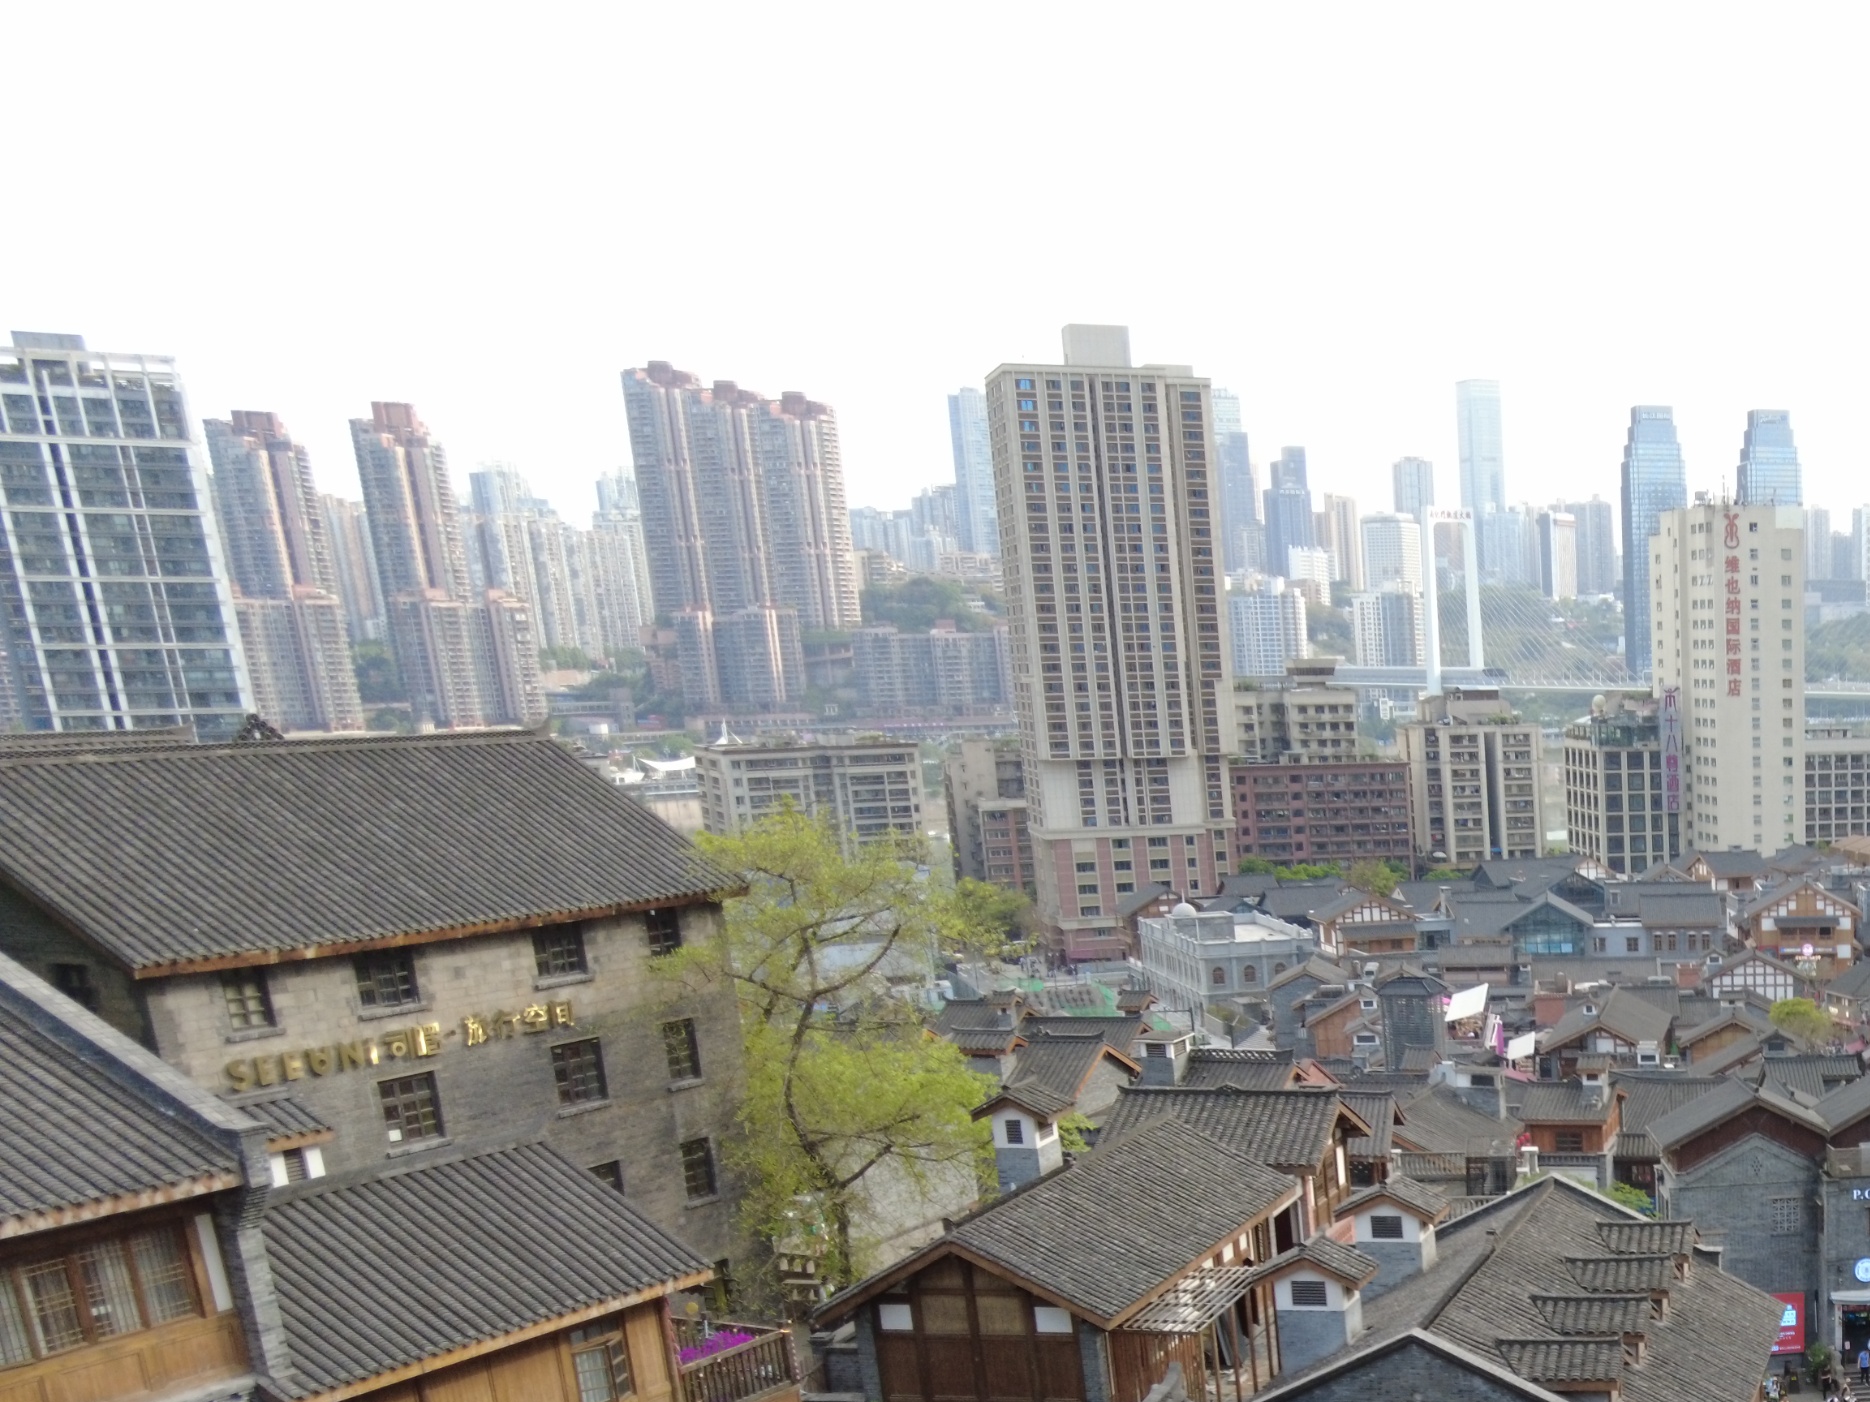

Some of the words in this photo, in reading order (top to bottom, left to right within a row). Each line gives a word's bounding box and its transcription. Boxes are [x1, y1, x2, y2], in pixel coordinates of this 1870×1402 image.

[1724, 555, 1742, 697] 维也纳国际酒店
